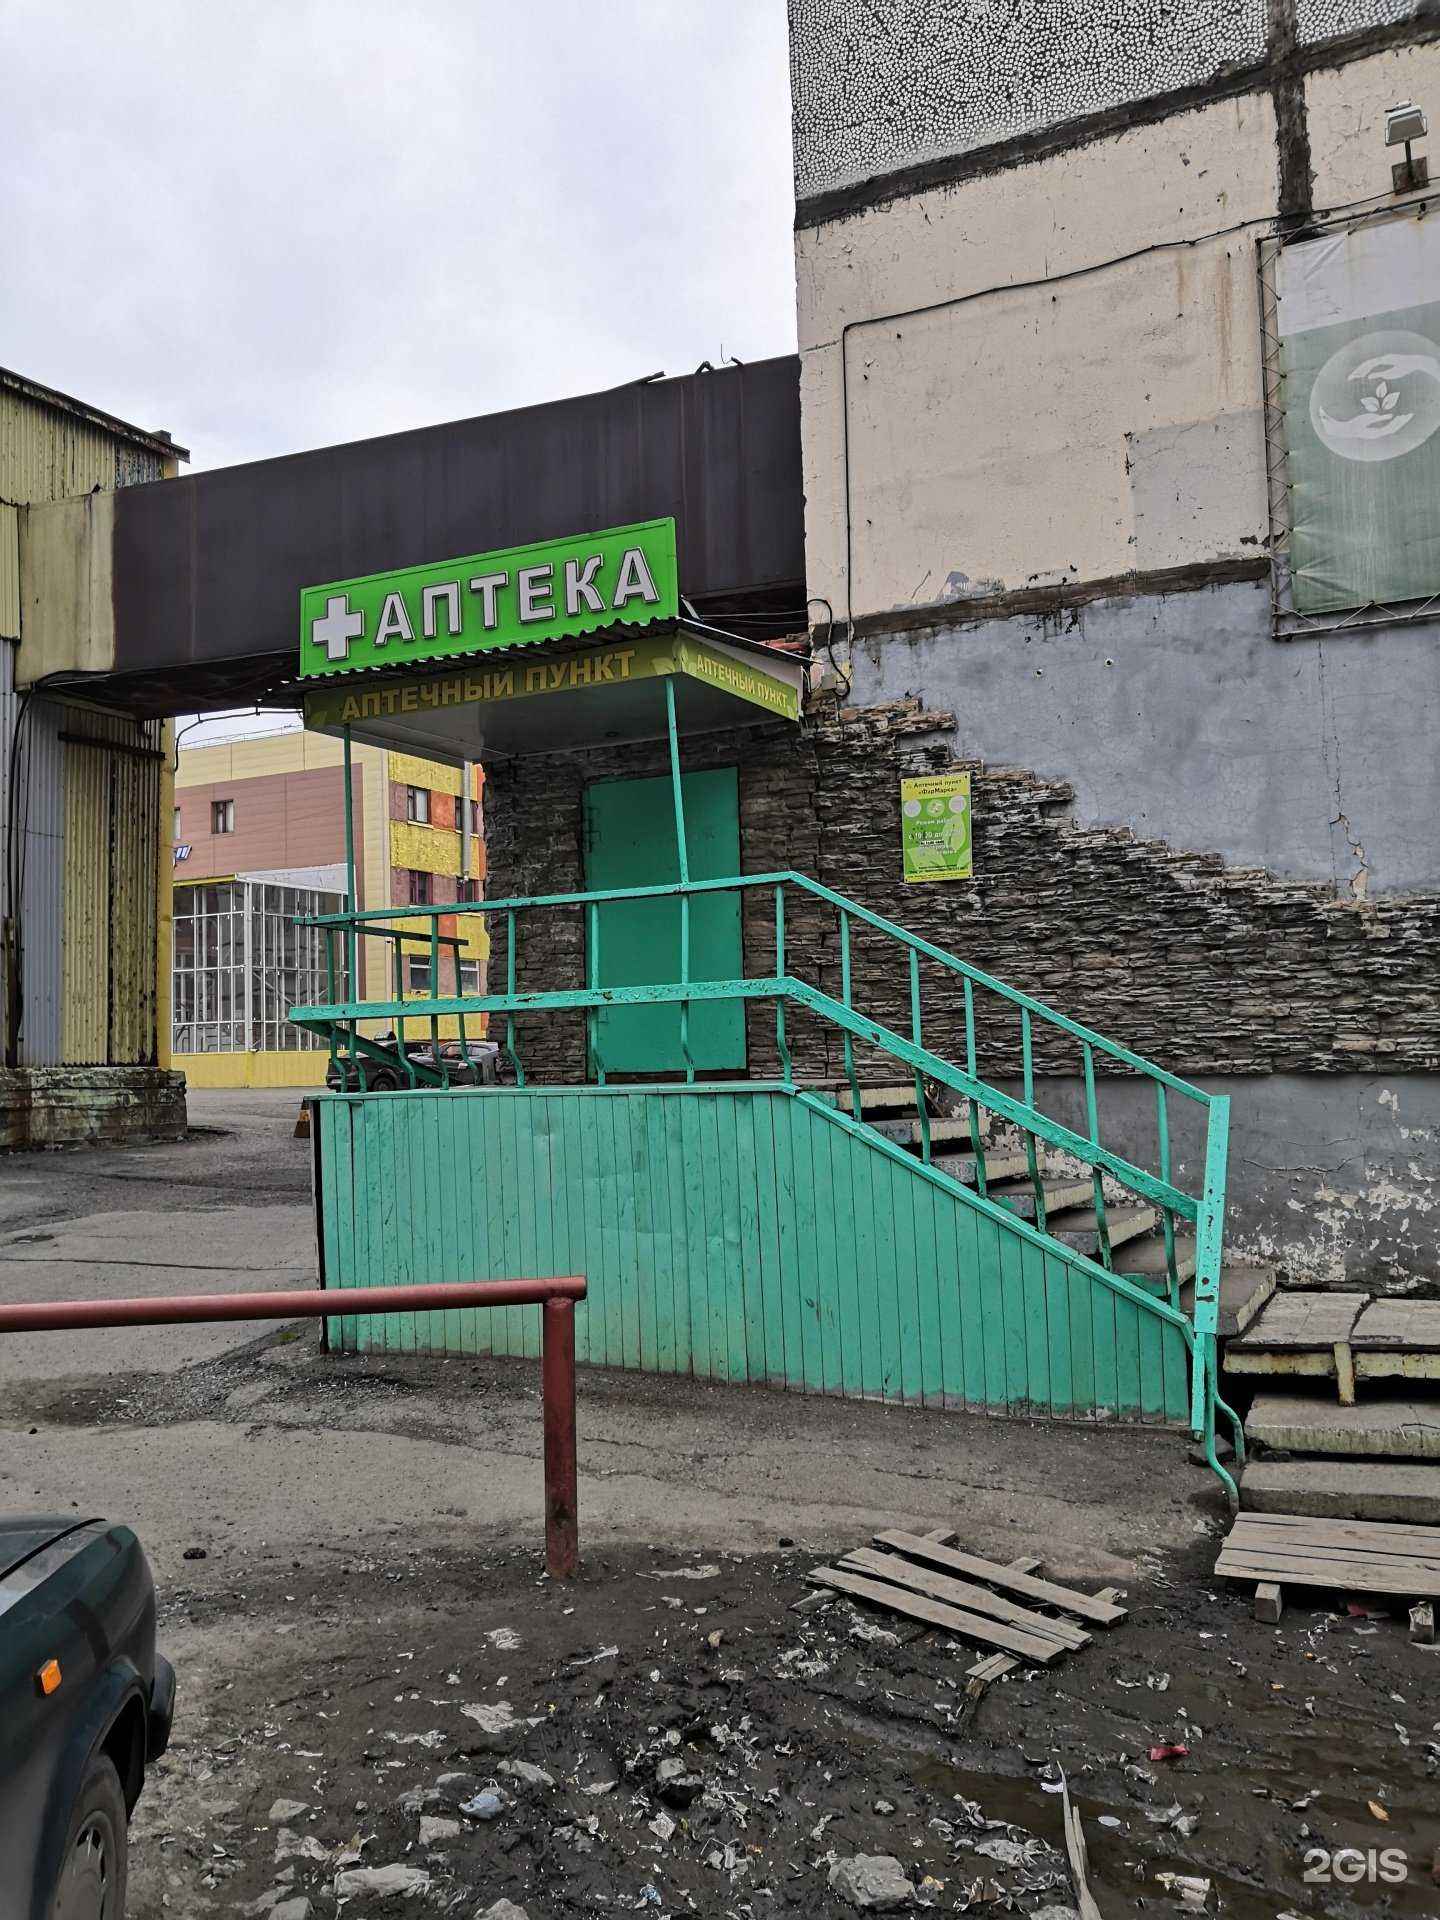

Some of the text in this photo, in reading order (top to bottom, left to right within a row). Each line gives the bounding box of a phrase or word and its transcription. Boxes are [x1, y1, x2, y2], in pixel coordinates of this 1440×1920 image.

[373, 546, 660, 647] АПТЕКА
[342, 649, 635, 721] АПТЕЧНЫЙ ПУНКТ
[697, 654, 788, 708] АПТЕЧНЫЙ ПУНКТ
